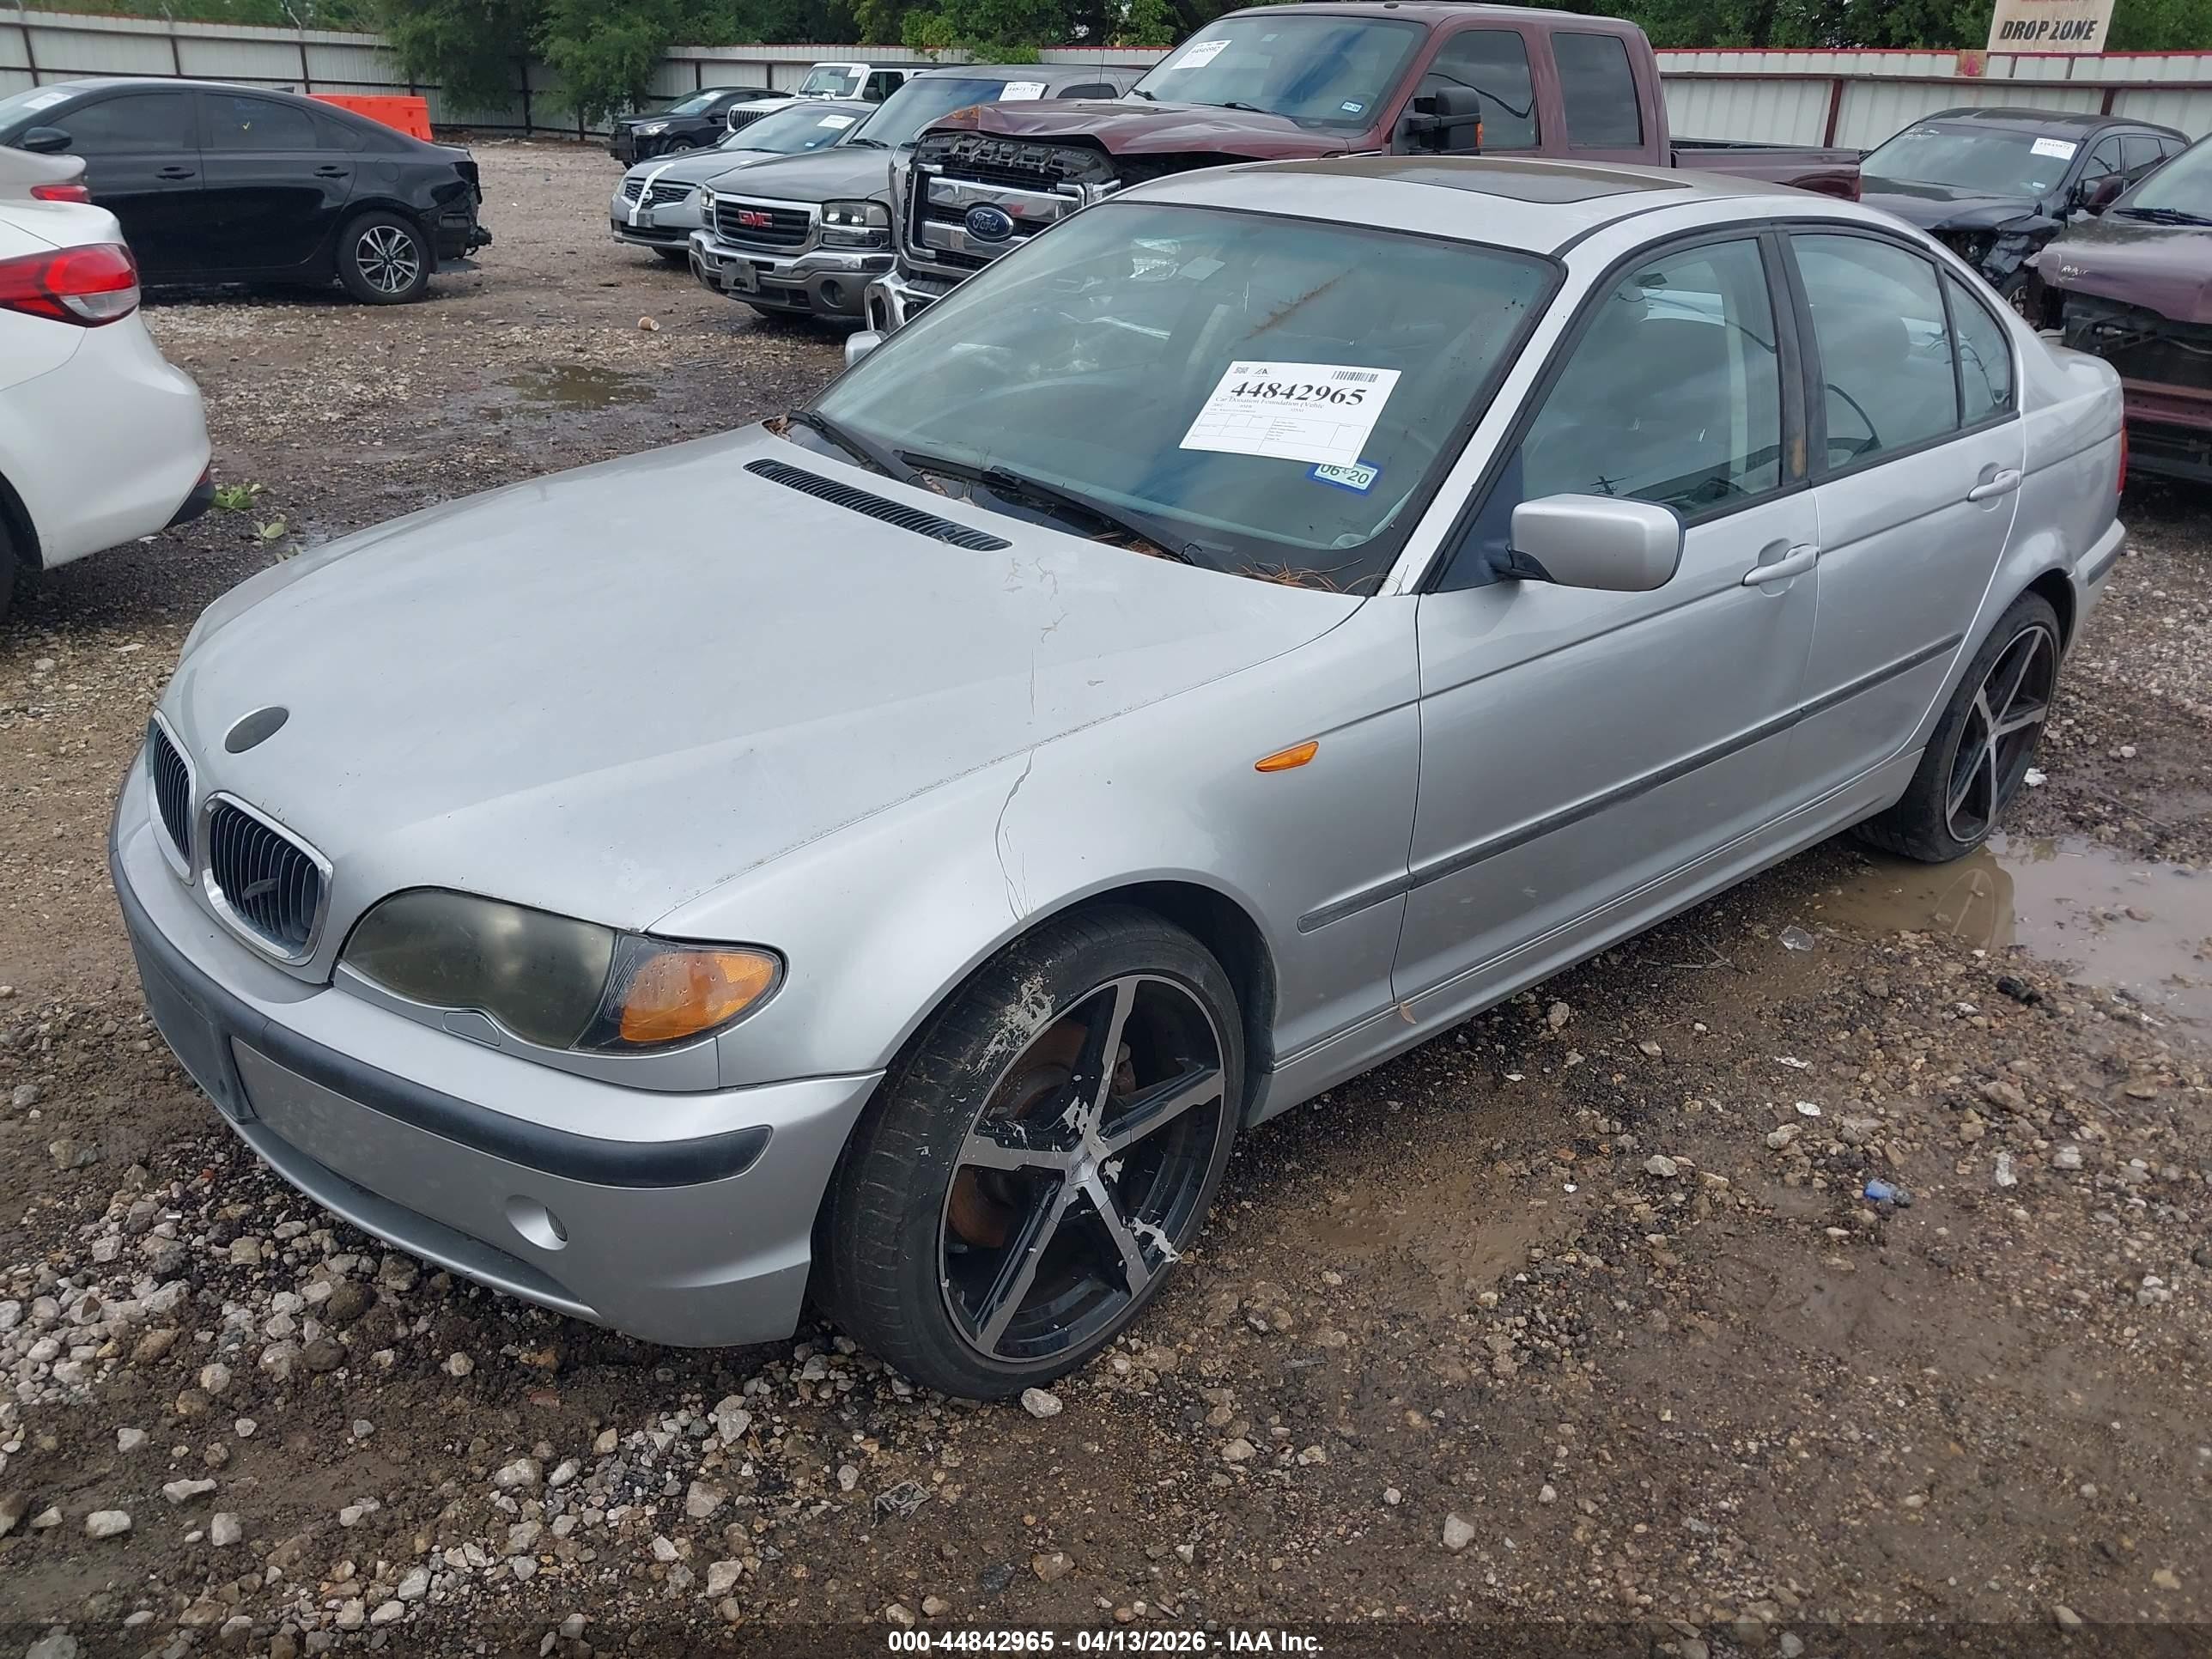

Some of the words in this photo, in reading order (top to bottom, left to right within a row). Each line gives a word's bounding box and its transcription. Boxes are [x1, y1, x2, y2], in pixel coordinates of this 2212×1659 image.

[1999, 21, 2050, 40] DROP
[2049, 21, 2098, 40] ZONE
[738, 210, 773, 228] GMC
[972, 211, 999, 232] Ford
[1228, 396, 1260, 404] Donation
[1260, 398, 1299, 407] Foundation
[1231, 381, 1367, 406] 44842965
